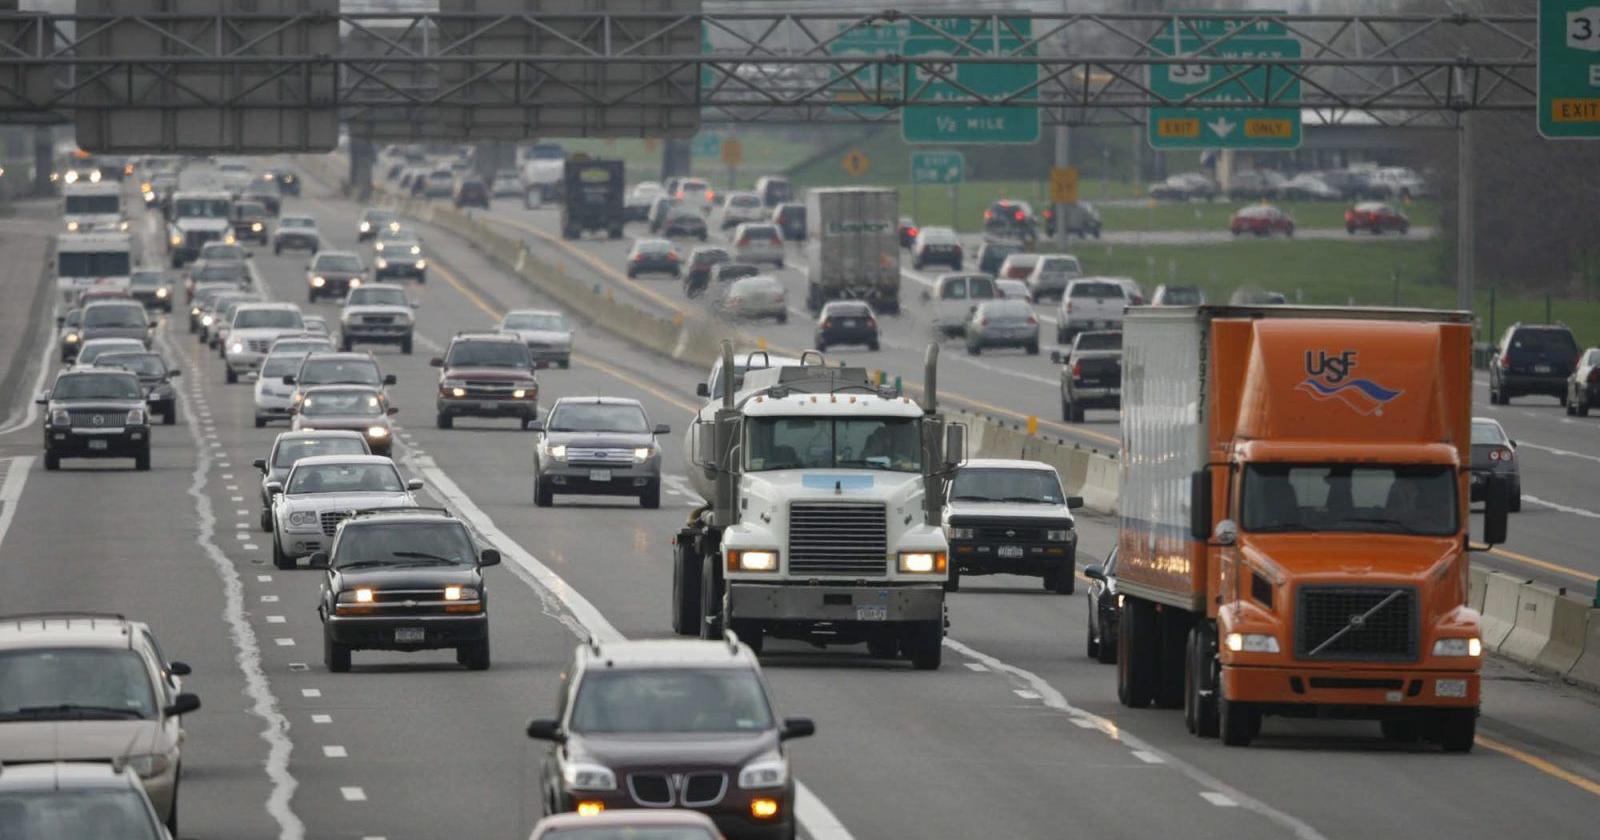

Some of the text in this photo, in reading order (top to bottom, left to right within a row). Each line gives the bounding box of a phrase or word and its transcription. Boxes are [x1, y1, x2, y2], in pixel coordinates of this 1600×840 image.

[1571, 17, 1600, 41] 3
[1561, 103, 1597, 118] EXIT
[967, 117, 1005, 130] MILE
[1163, 120, 1284, 134] EXIT ONLY
[1304, 349, 1359, 384] USF
